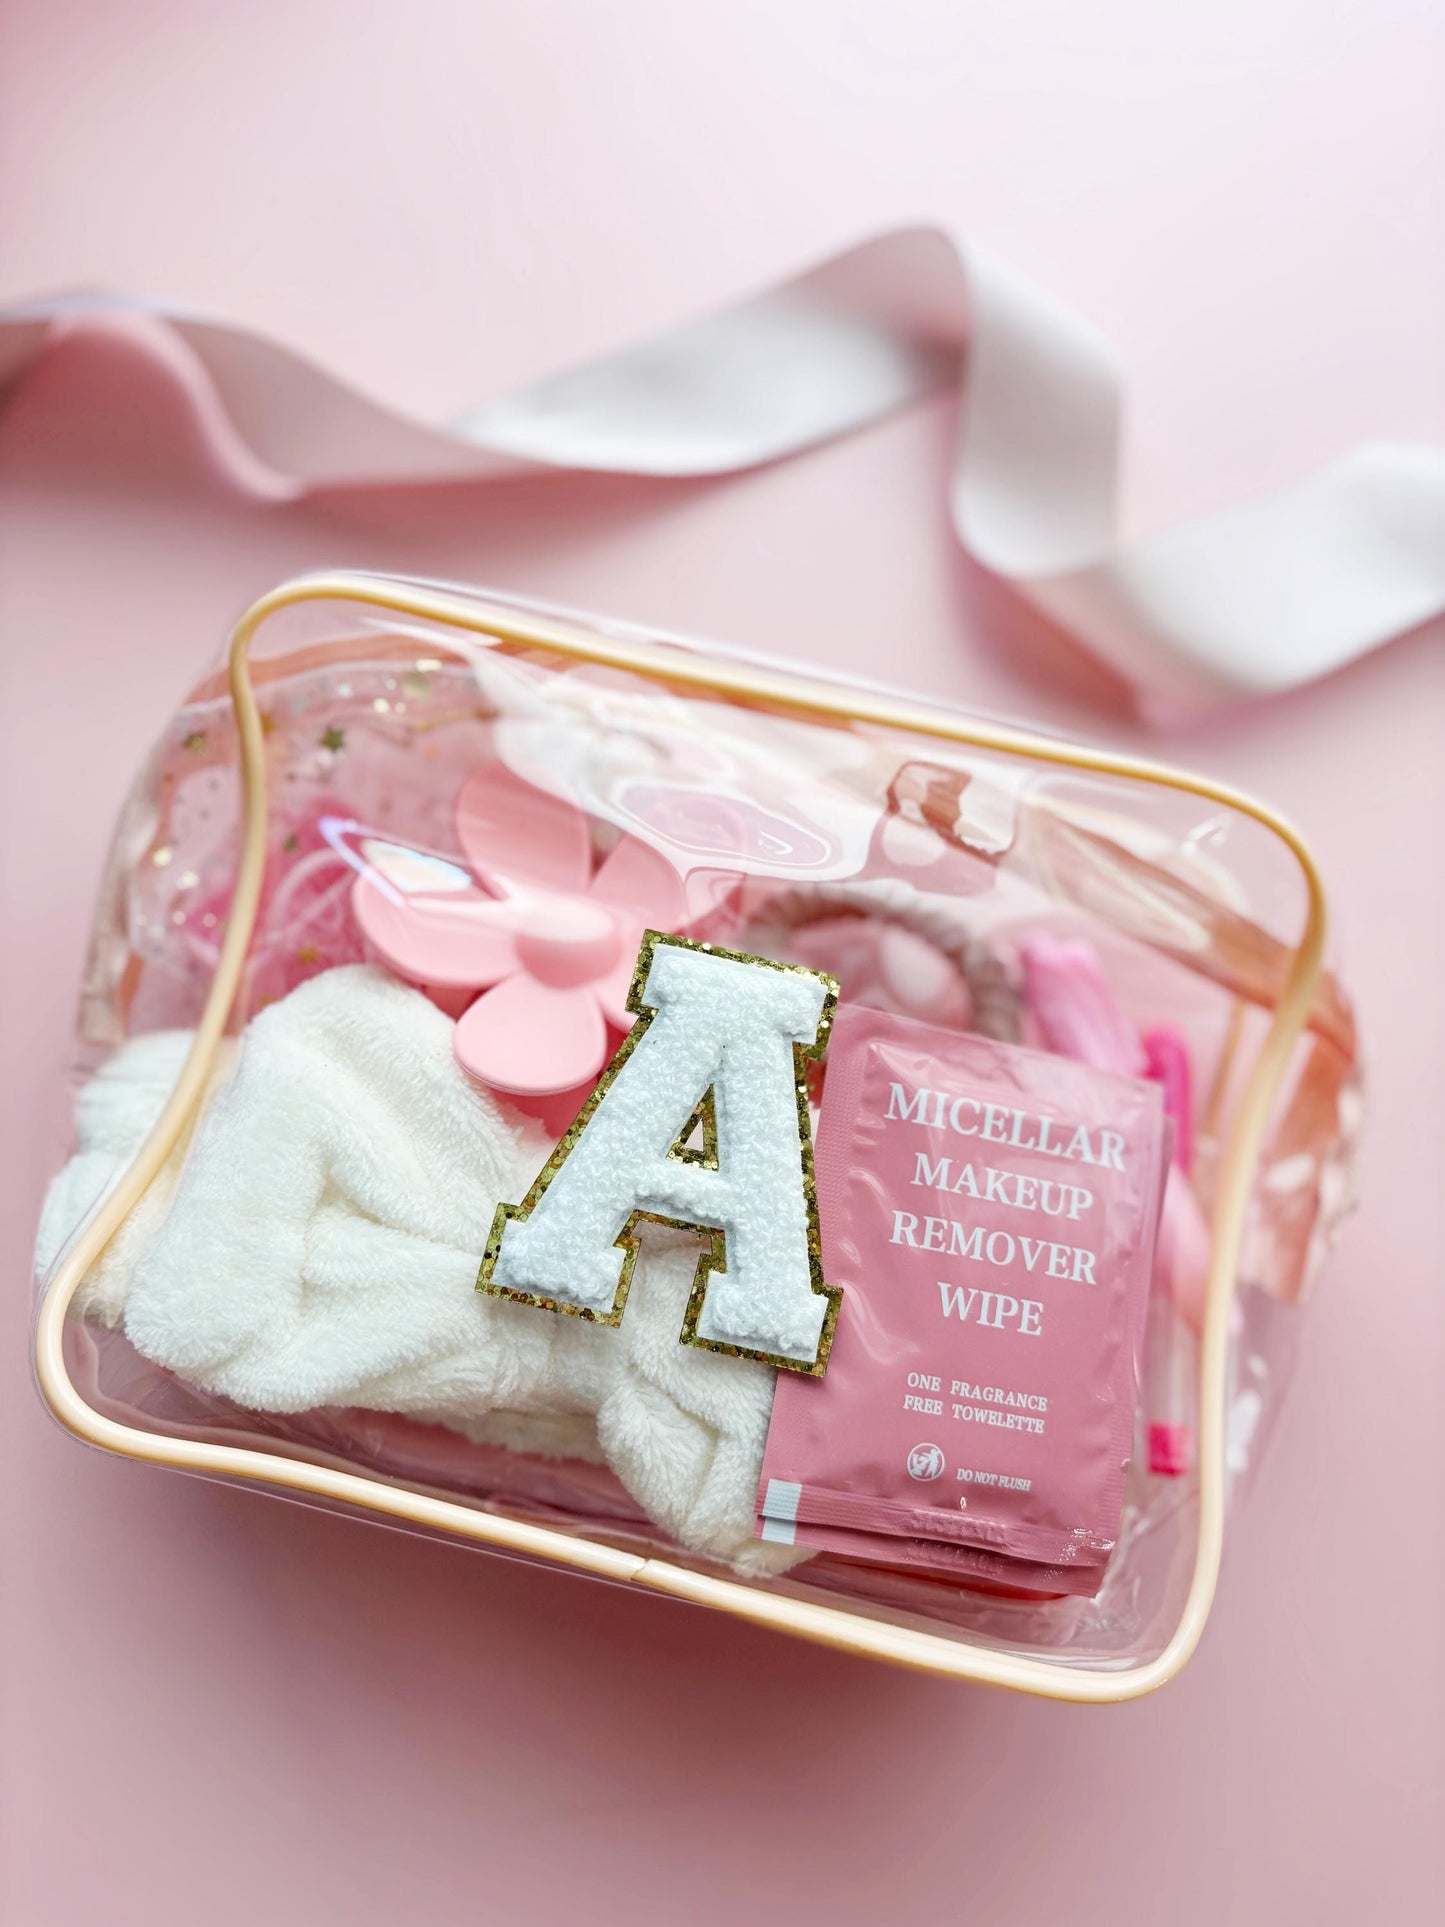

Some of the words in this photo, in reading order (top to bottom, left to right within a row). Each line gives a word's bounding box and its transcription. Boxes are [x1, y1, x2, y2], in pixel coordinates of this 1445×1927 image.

[475, 929, 844, 1378] A
[884, 1082, 1126, 1172] MICELLAR
[910, 1152, 1093, 1221] MAKEUP
[889, 1210, 1097, 1285] REMOVER
[937, 1281, 1044, 1336] WIPE
[903, 1394, 944, 1416] FREE
[952, 1404, 1045, 1434] TOWELETTE
[907, 1372, 941, 1392] ONE
[950, 1380, 1048, 1412] FRAGRANCE
[956, 1468, 973, 1481] DO
[974, 1471, 998, 1486] NOT
[998, 1475, 1031, 1491] FLUSH
